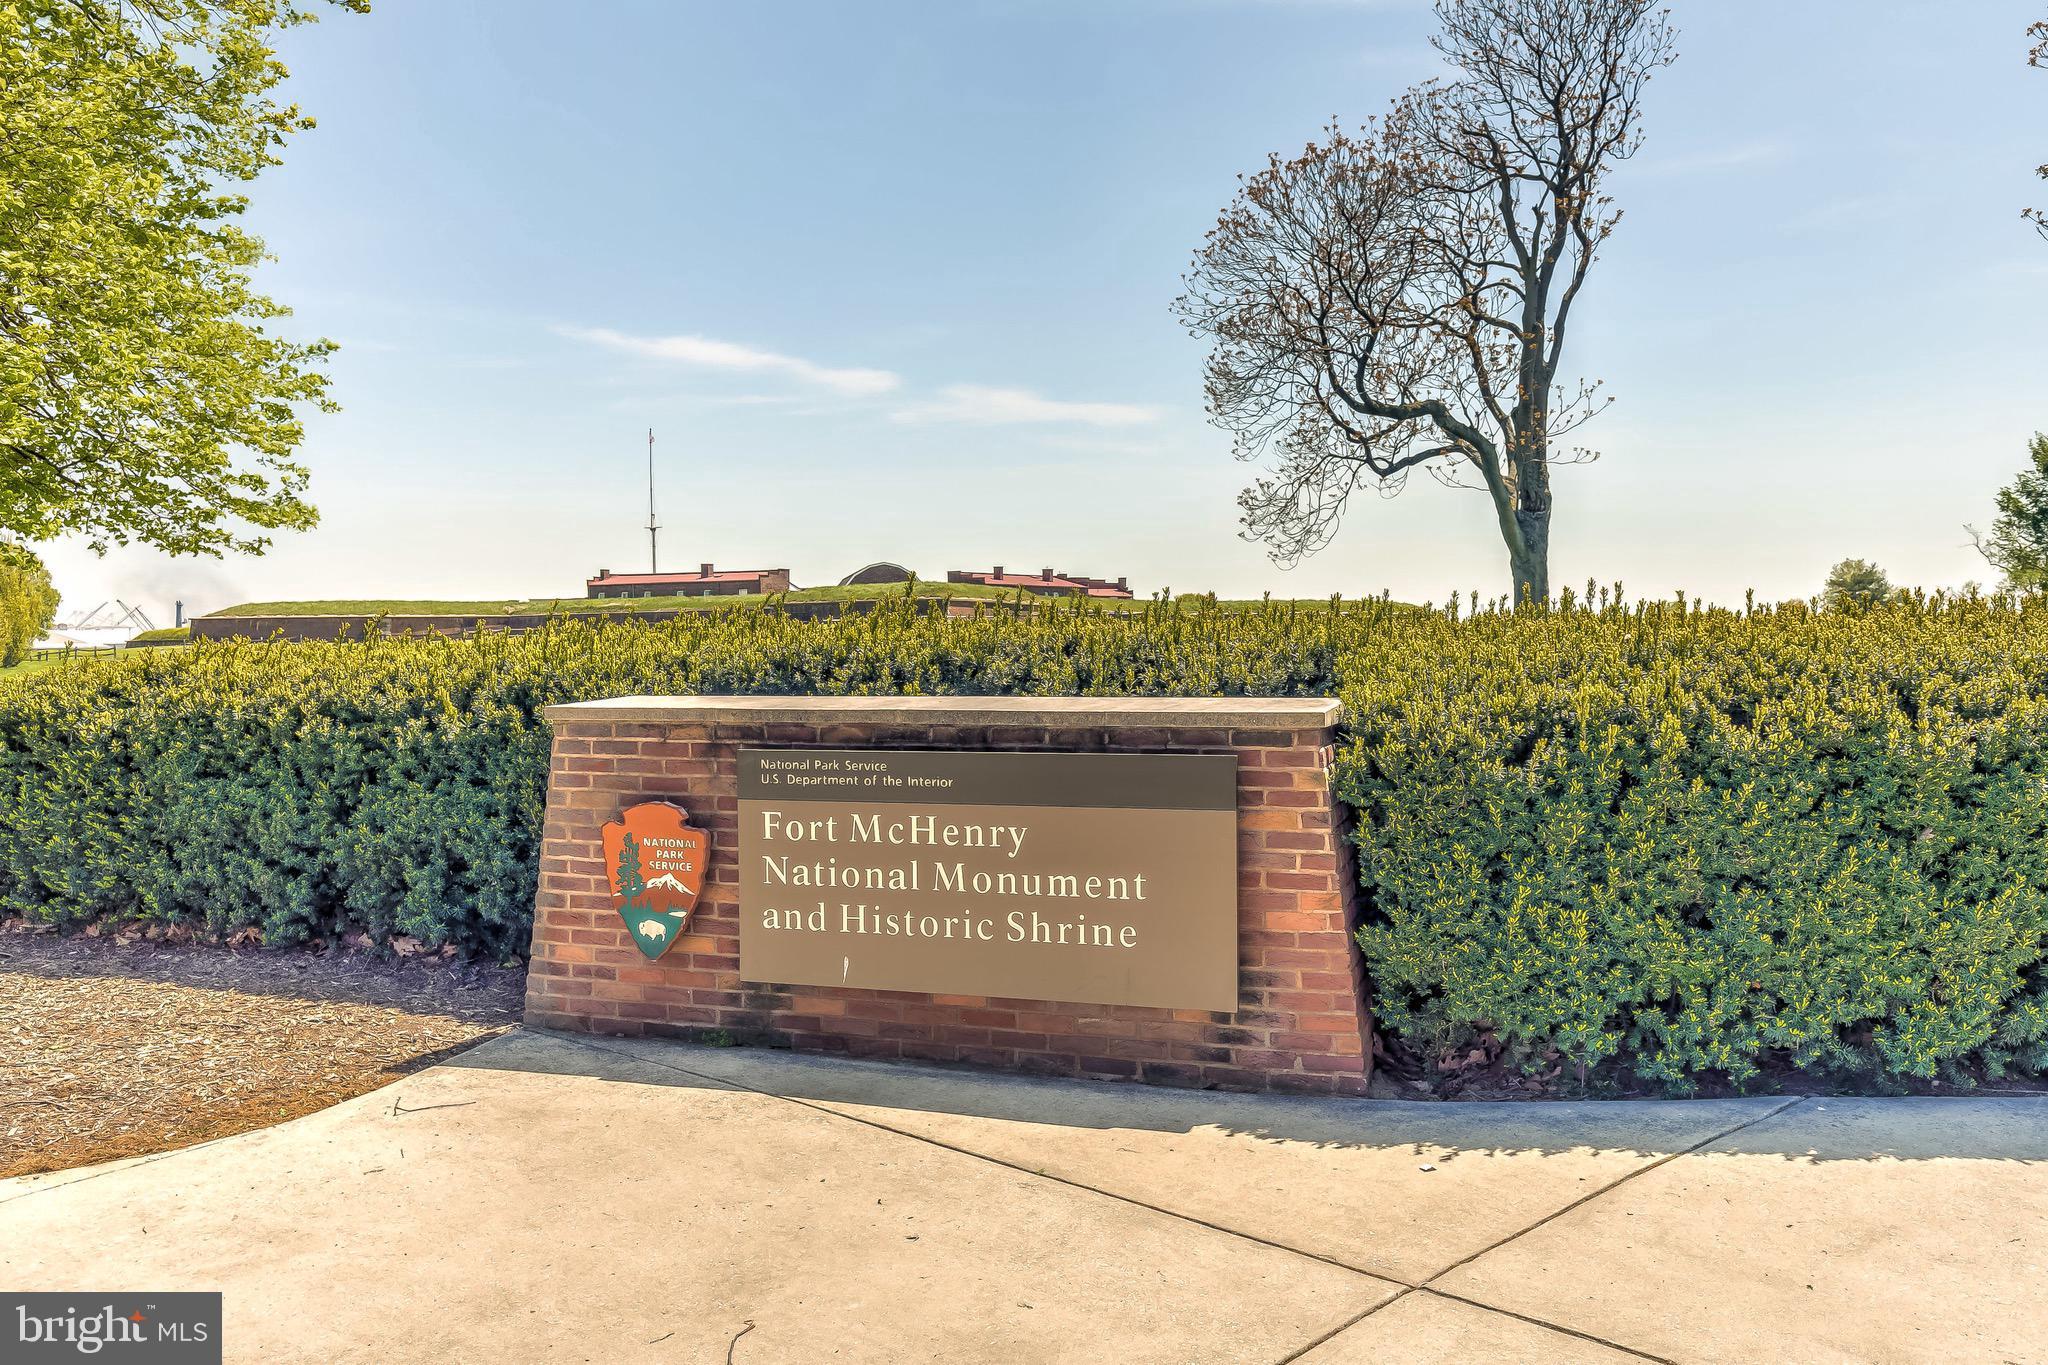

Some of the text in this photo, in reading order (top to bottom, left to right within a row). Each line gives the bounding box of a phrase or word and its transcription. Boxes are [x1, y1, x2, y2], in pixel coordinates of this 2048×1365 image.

[761, 759, 887, 772] National Park Service
[761, 774, 953, 788] U.S. Department of the Interior
[761, 811, 1028, 858] Fort McHenry
[643, 838, 696, 848] NATIONAL
[656, 850, 684, 860] PARK
[649, 860, 692, 872] SERVICE
[761, 855, 1147, 900] National Monument
[761, 902, 1138, 948] and Historic Shrine
